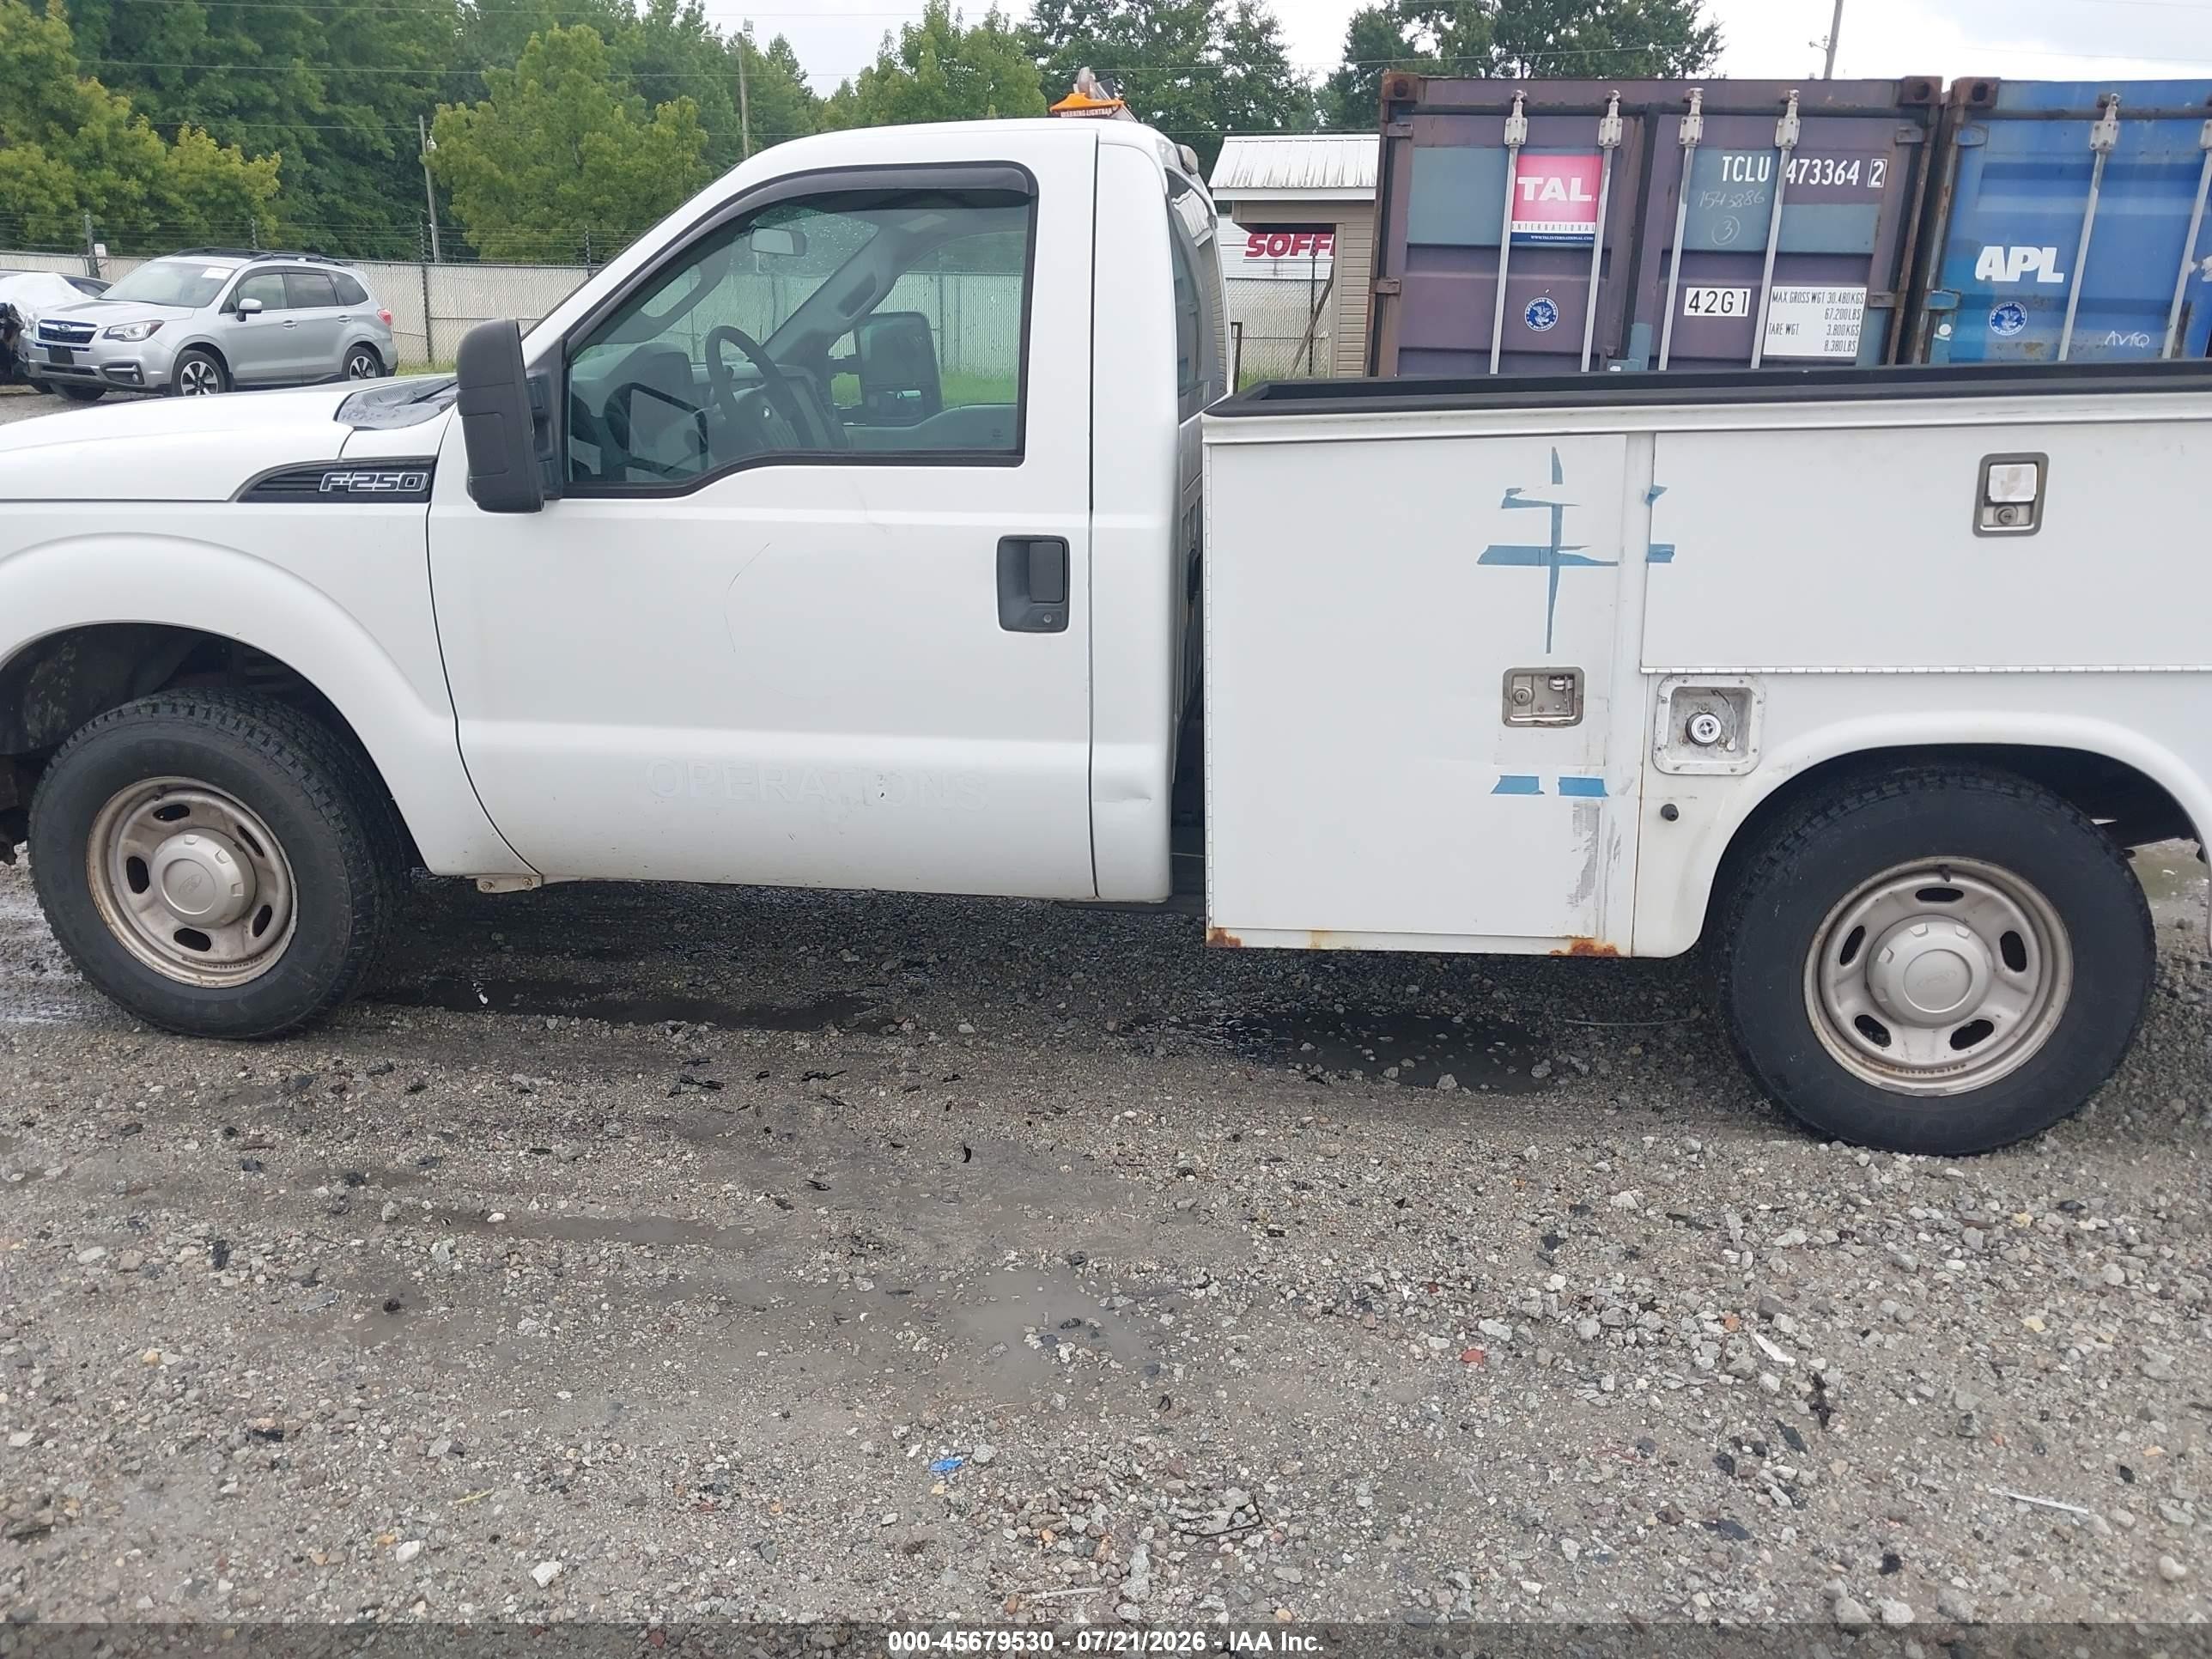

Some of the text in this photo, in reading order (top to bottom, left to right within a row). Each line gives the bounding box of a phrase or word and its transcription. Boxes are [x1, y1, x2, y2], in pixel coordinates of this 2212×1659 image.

[1722, 155, 1886, 187] TCLU 473364 2
[1516, 176, 1593, 202] TAL
[1511, 223, 1595, 232] INTERNATIONAL
[1244, 233, 1335, 258] SOFF
[1975, 246, 2065, 283] APL
[1687, 289, 1748, 314] 42G1
[1771, 290, 1788, 303] MAX
[1789, 291, 1810, 304] GROSS
[1811, 291, 1826, 304] WGT
[1768, 322, 1784, 336] TARE
[1785, 323, 1800, 336] WGT
[319, 471, 429, 493] F-250
